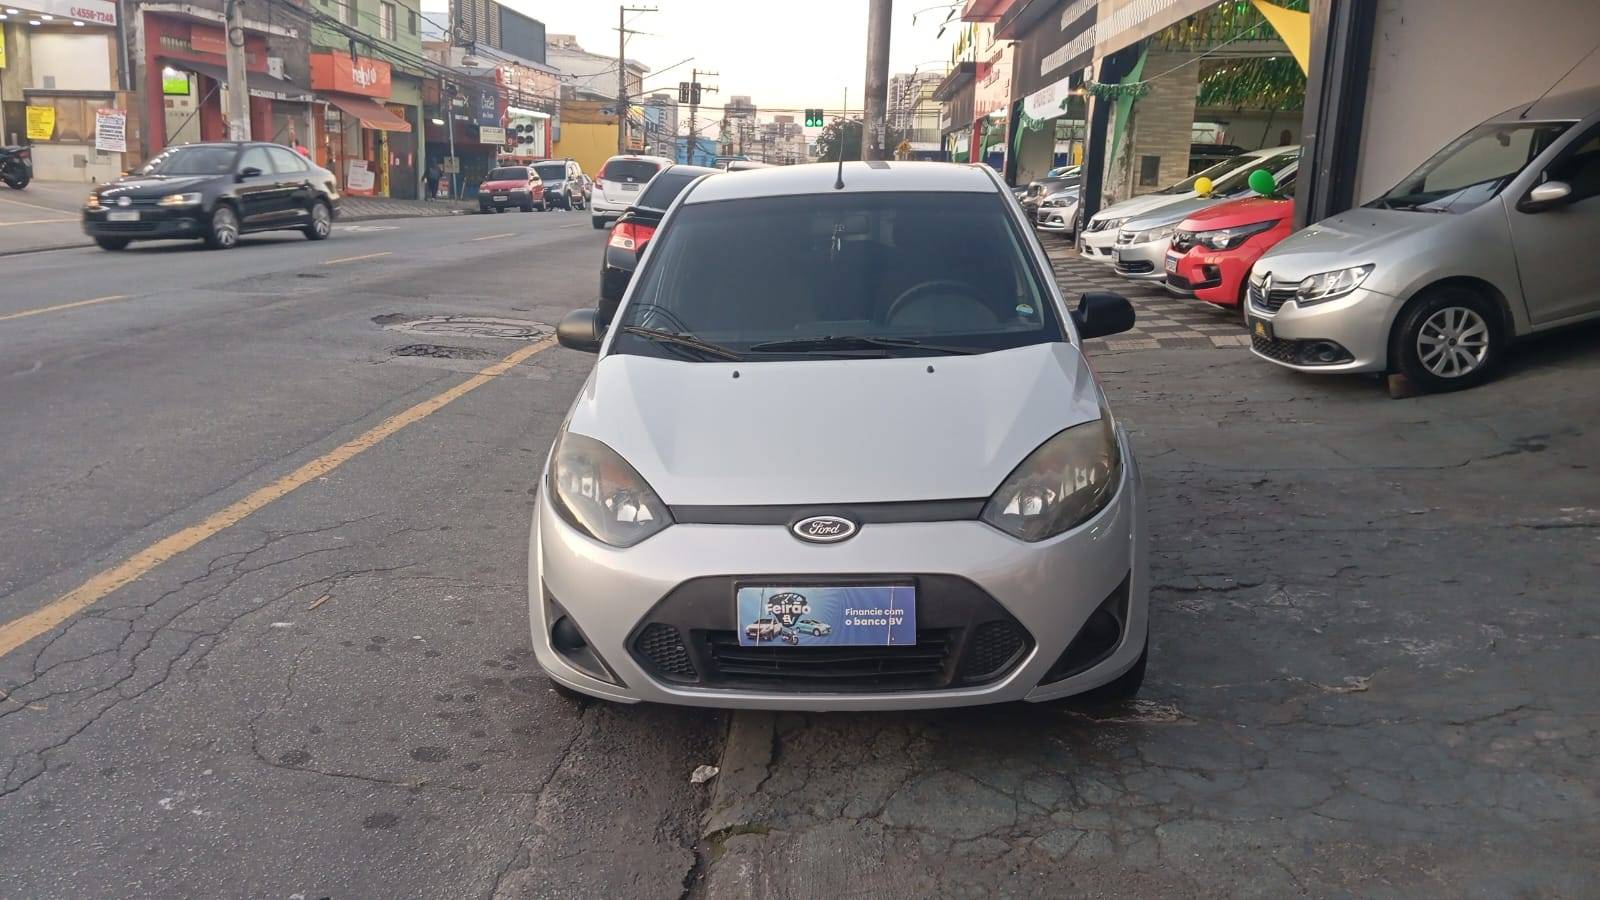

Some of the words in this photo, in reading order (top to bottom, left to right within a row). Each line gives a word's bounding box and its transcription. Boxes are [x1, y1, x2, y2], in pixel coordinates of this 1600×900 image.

[809, 520, 840, 534] Ford
[765, 601, 811, 615] Feirão
[845, 608, 882, 616] Financie
[854, 617, 887, 626] banco
[888, 617, 903, 626] BV
